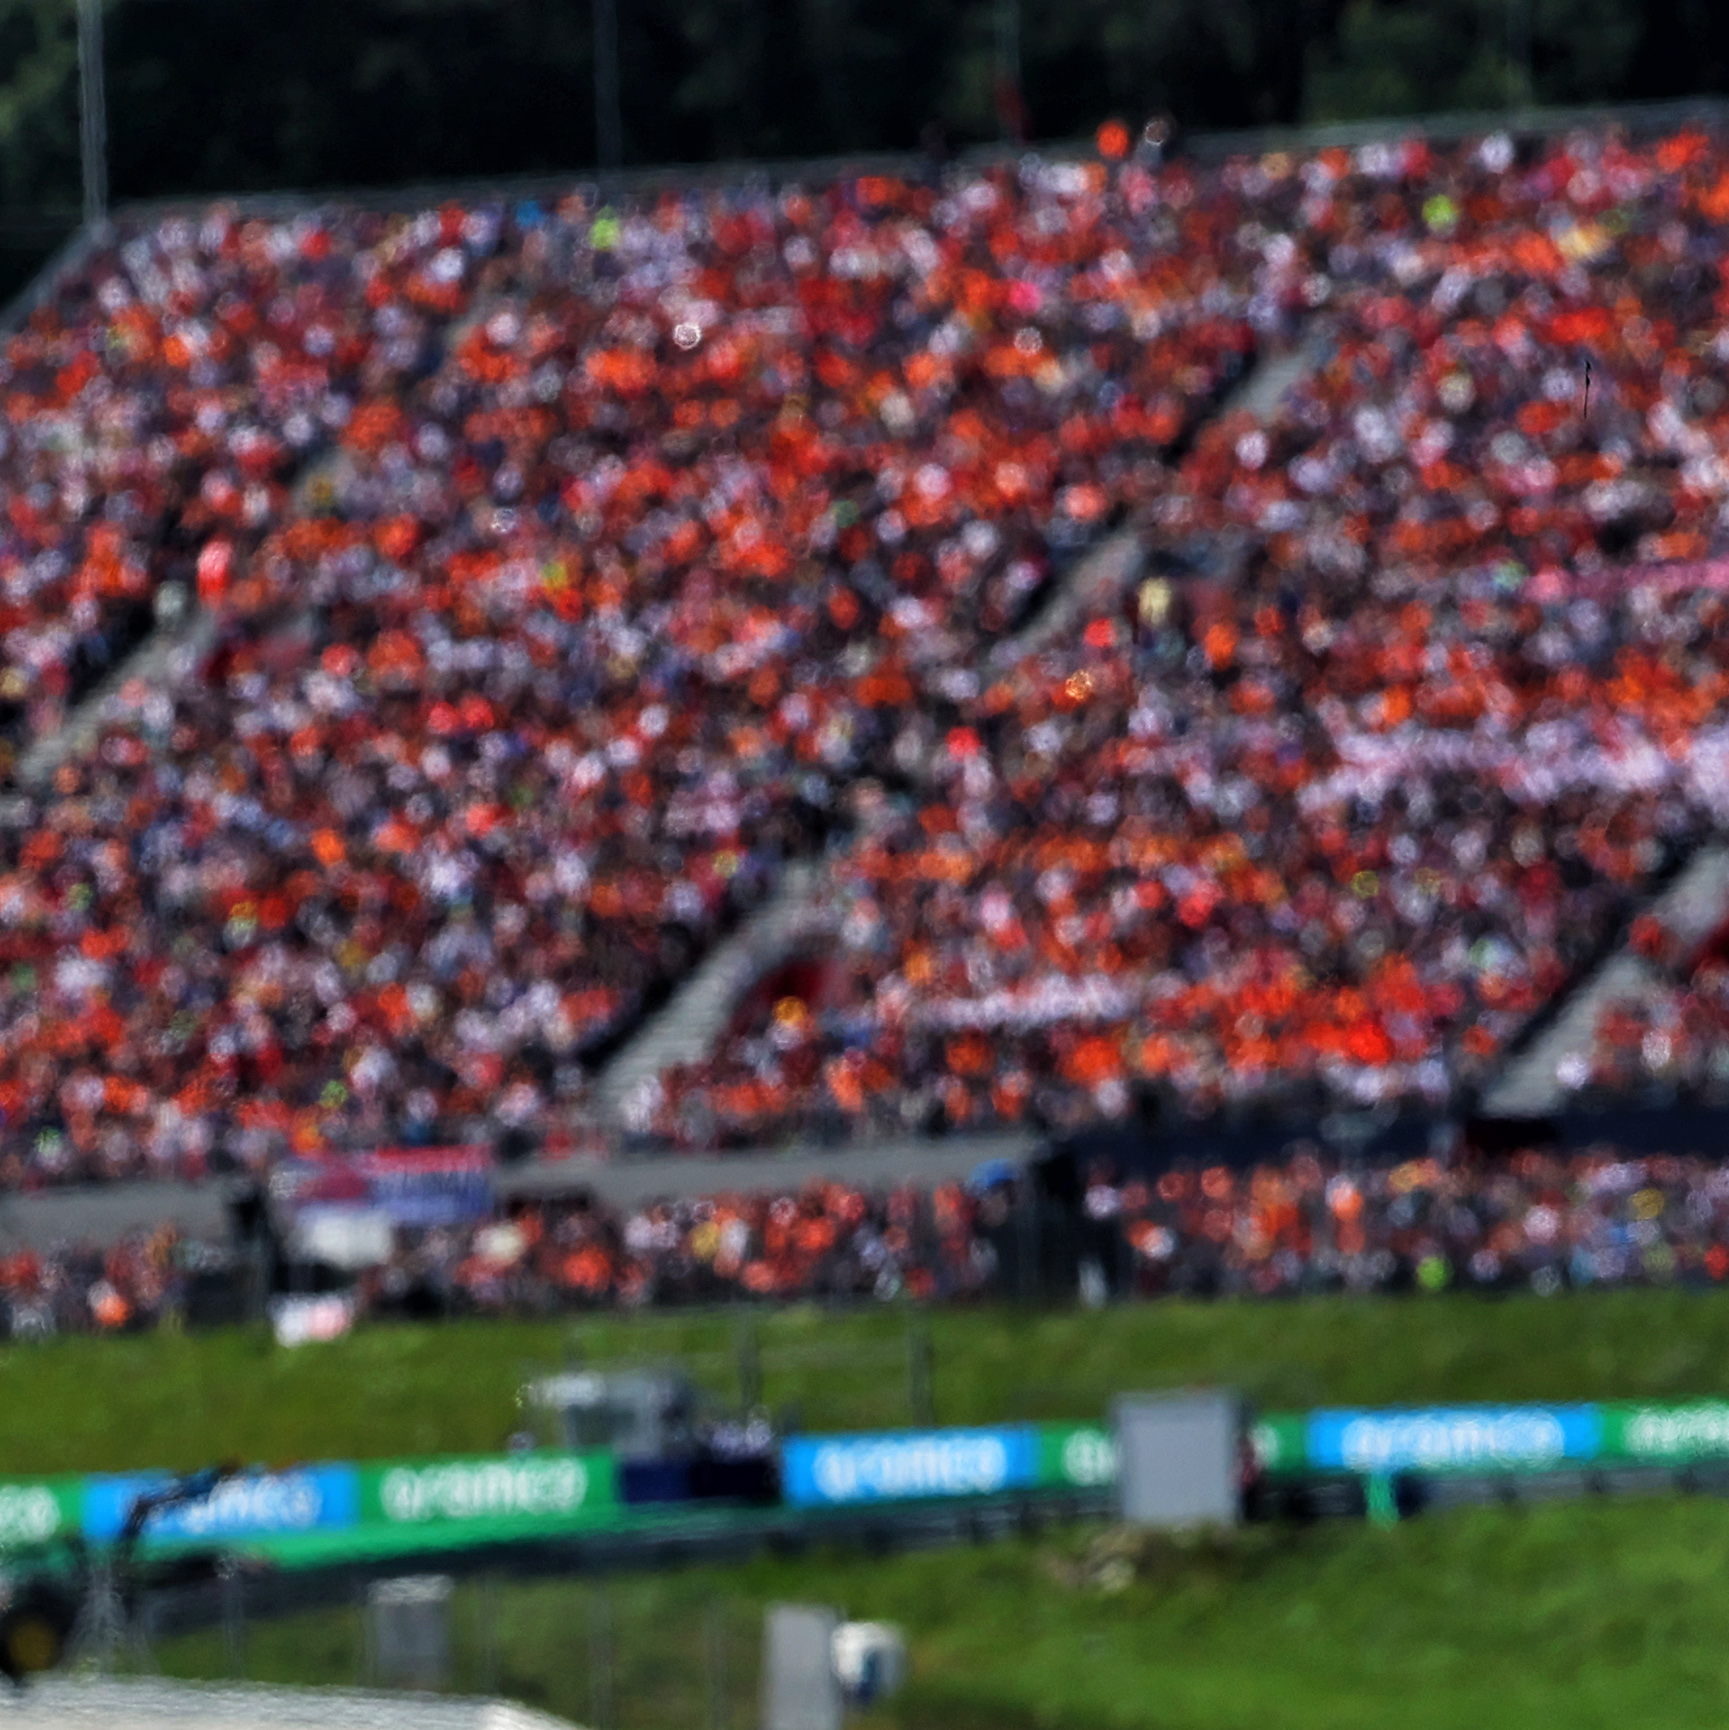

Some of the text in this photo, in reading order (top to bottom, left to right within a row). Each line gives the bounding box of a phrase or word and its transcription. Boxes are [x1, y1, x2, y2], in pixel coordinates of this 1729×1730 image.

[812, 1436, 1009, 1497] aramco
[1341, 1411, 1565, 1470] aramco
[379, 1457, 588, 1519] aramco
